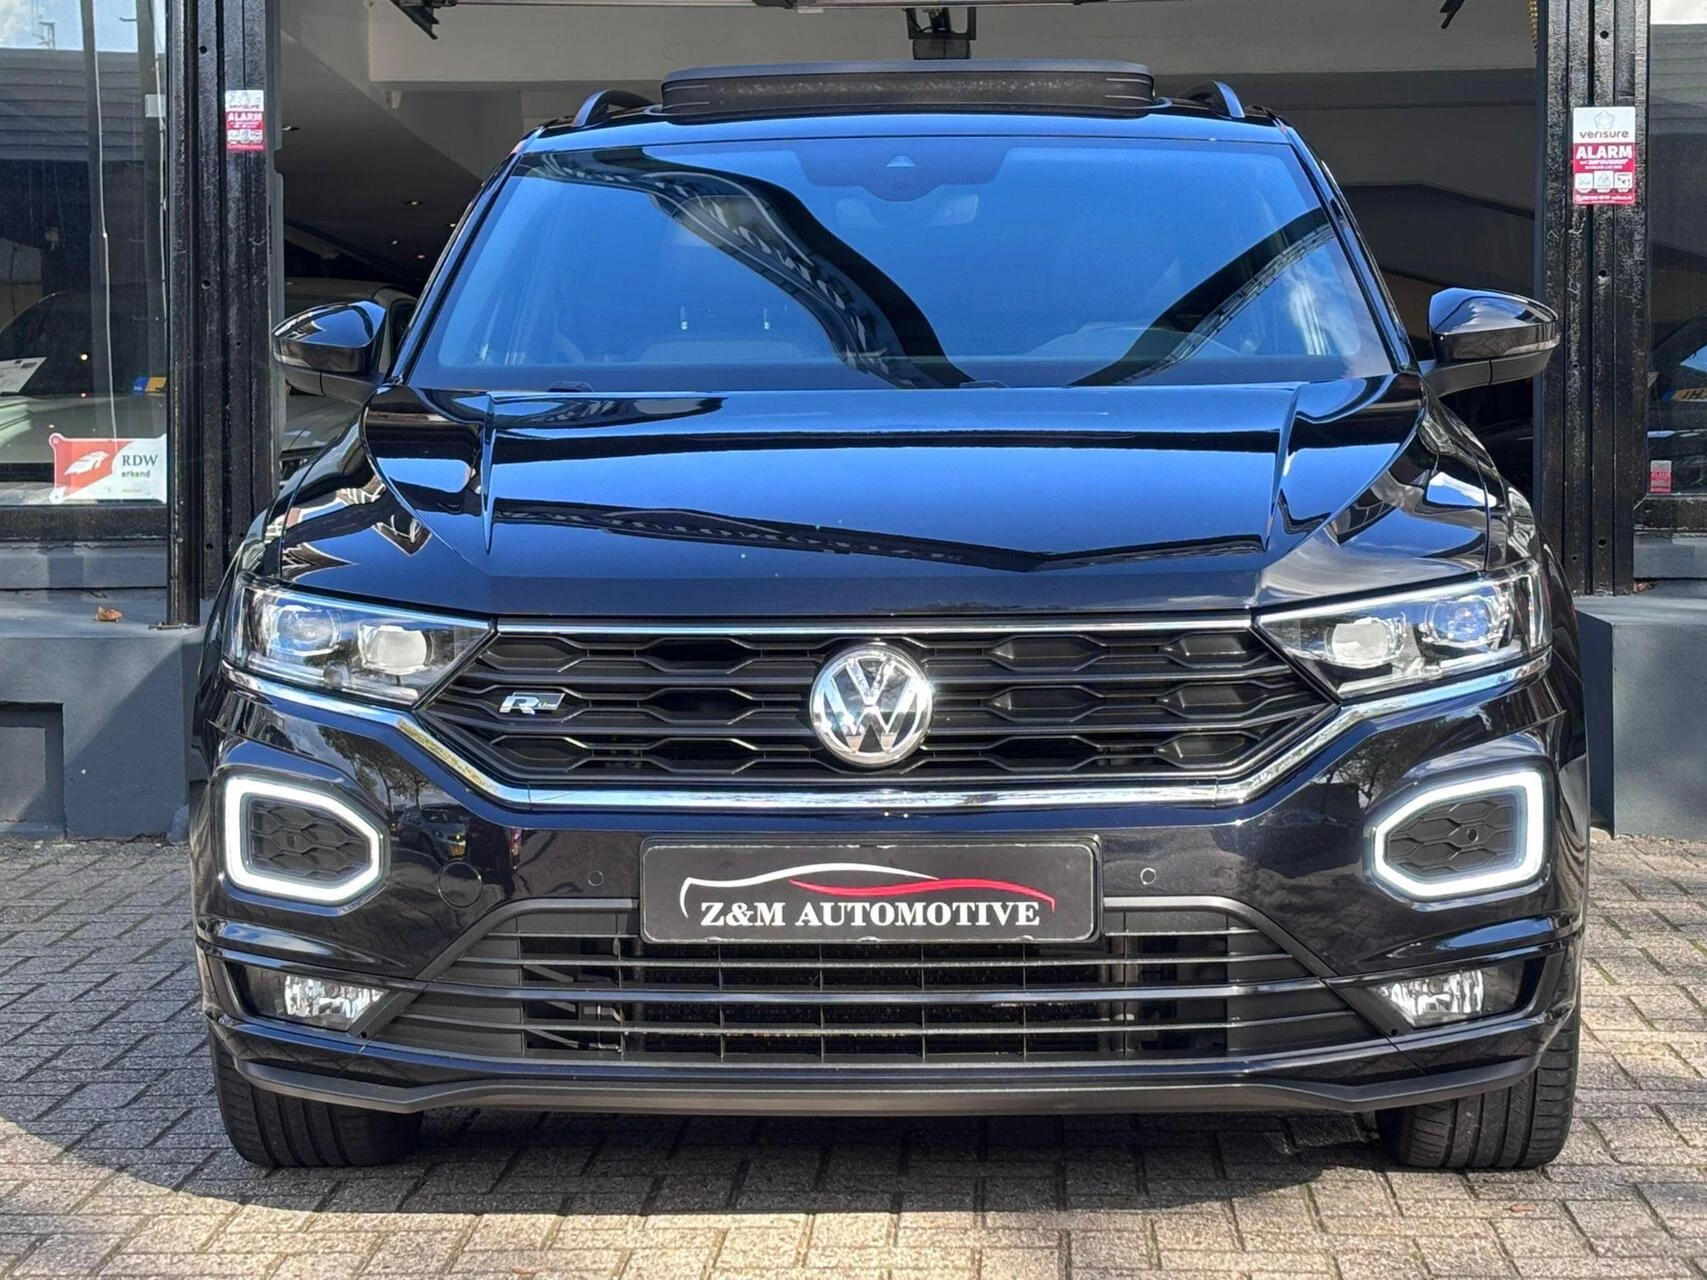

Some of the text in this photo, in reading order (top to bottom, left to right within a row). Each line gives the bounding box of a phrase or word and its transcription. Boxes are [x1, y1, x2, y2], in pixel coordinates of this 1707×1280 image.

[227, 112, 263, 121] ALARM
[1580, 130, 1629, 138] verisure
[1575, 145, 1633, 159] ALARM
[121, 454, 159, 467] RDW
[121, 469, 151, 478] erkend
[700, 901, 1041, 927] Z&M AUTOMOTIVE
